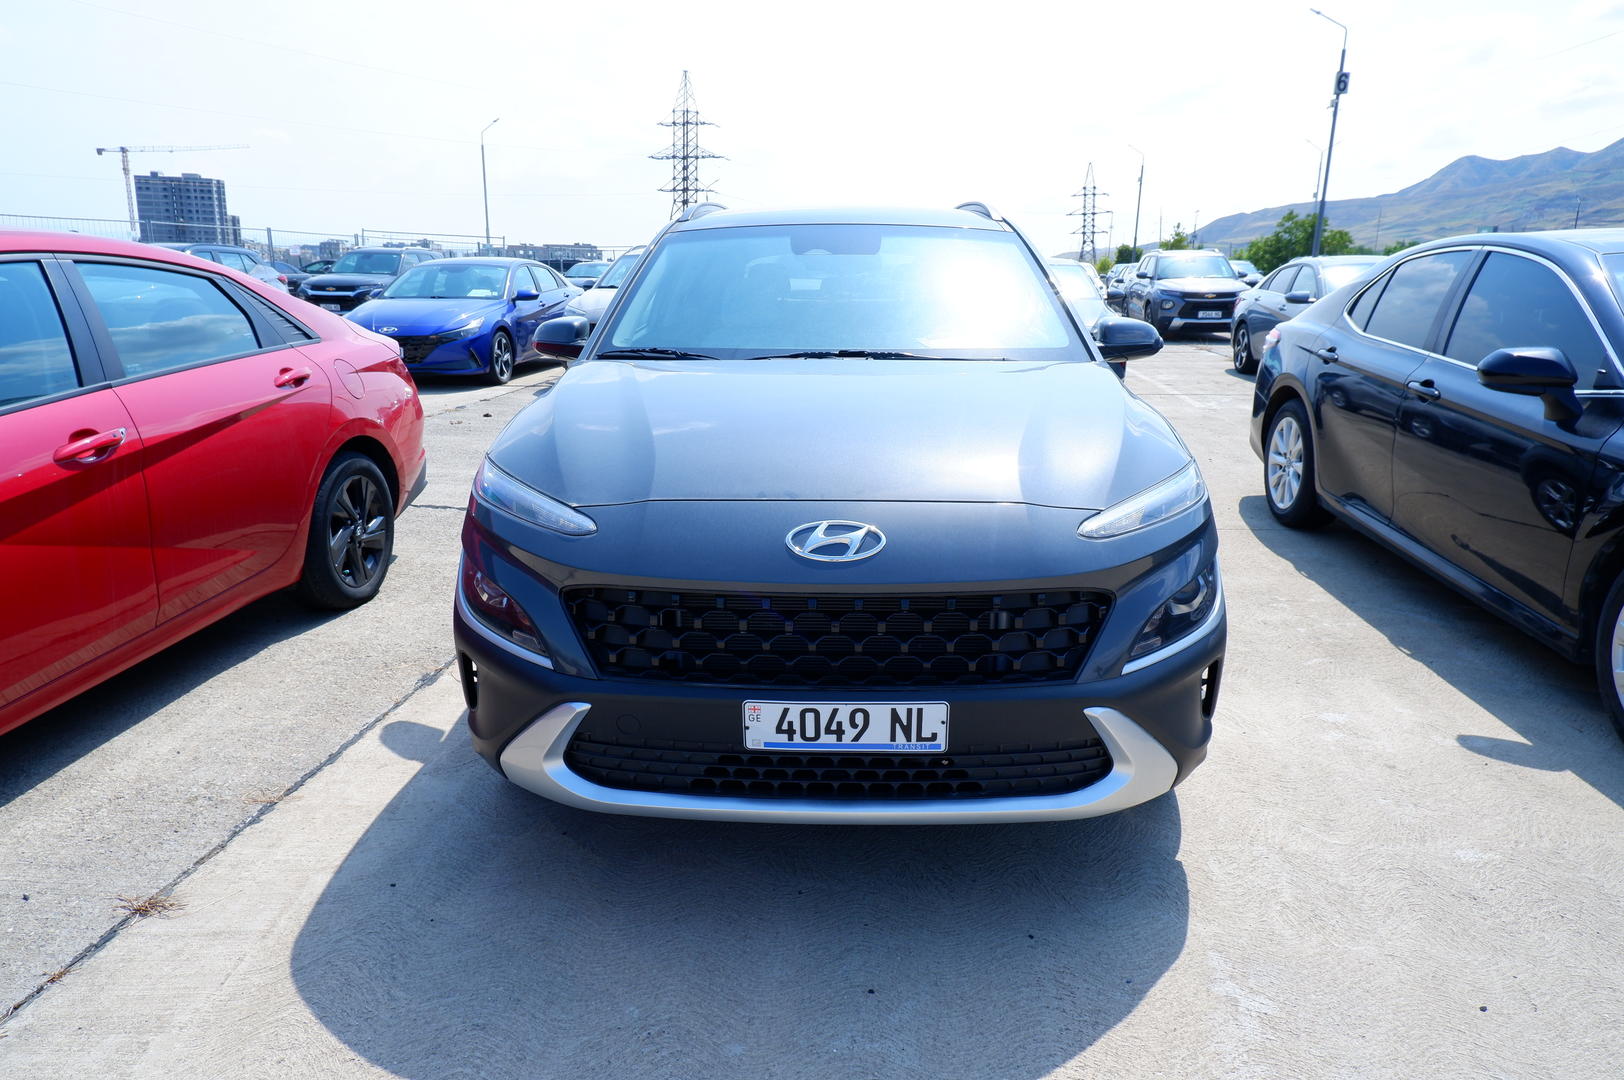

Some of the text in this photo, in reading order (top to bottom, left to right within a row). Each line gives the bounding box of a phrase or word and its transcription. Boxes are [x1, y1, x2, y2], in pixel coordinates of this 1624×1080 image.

[1337, 73, 1348, 91] 6
[748, 713, 761, 722] GE
[775, 707, 938, 742] 4049 NL
